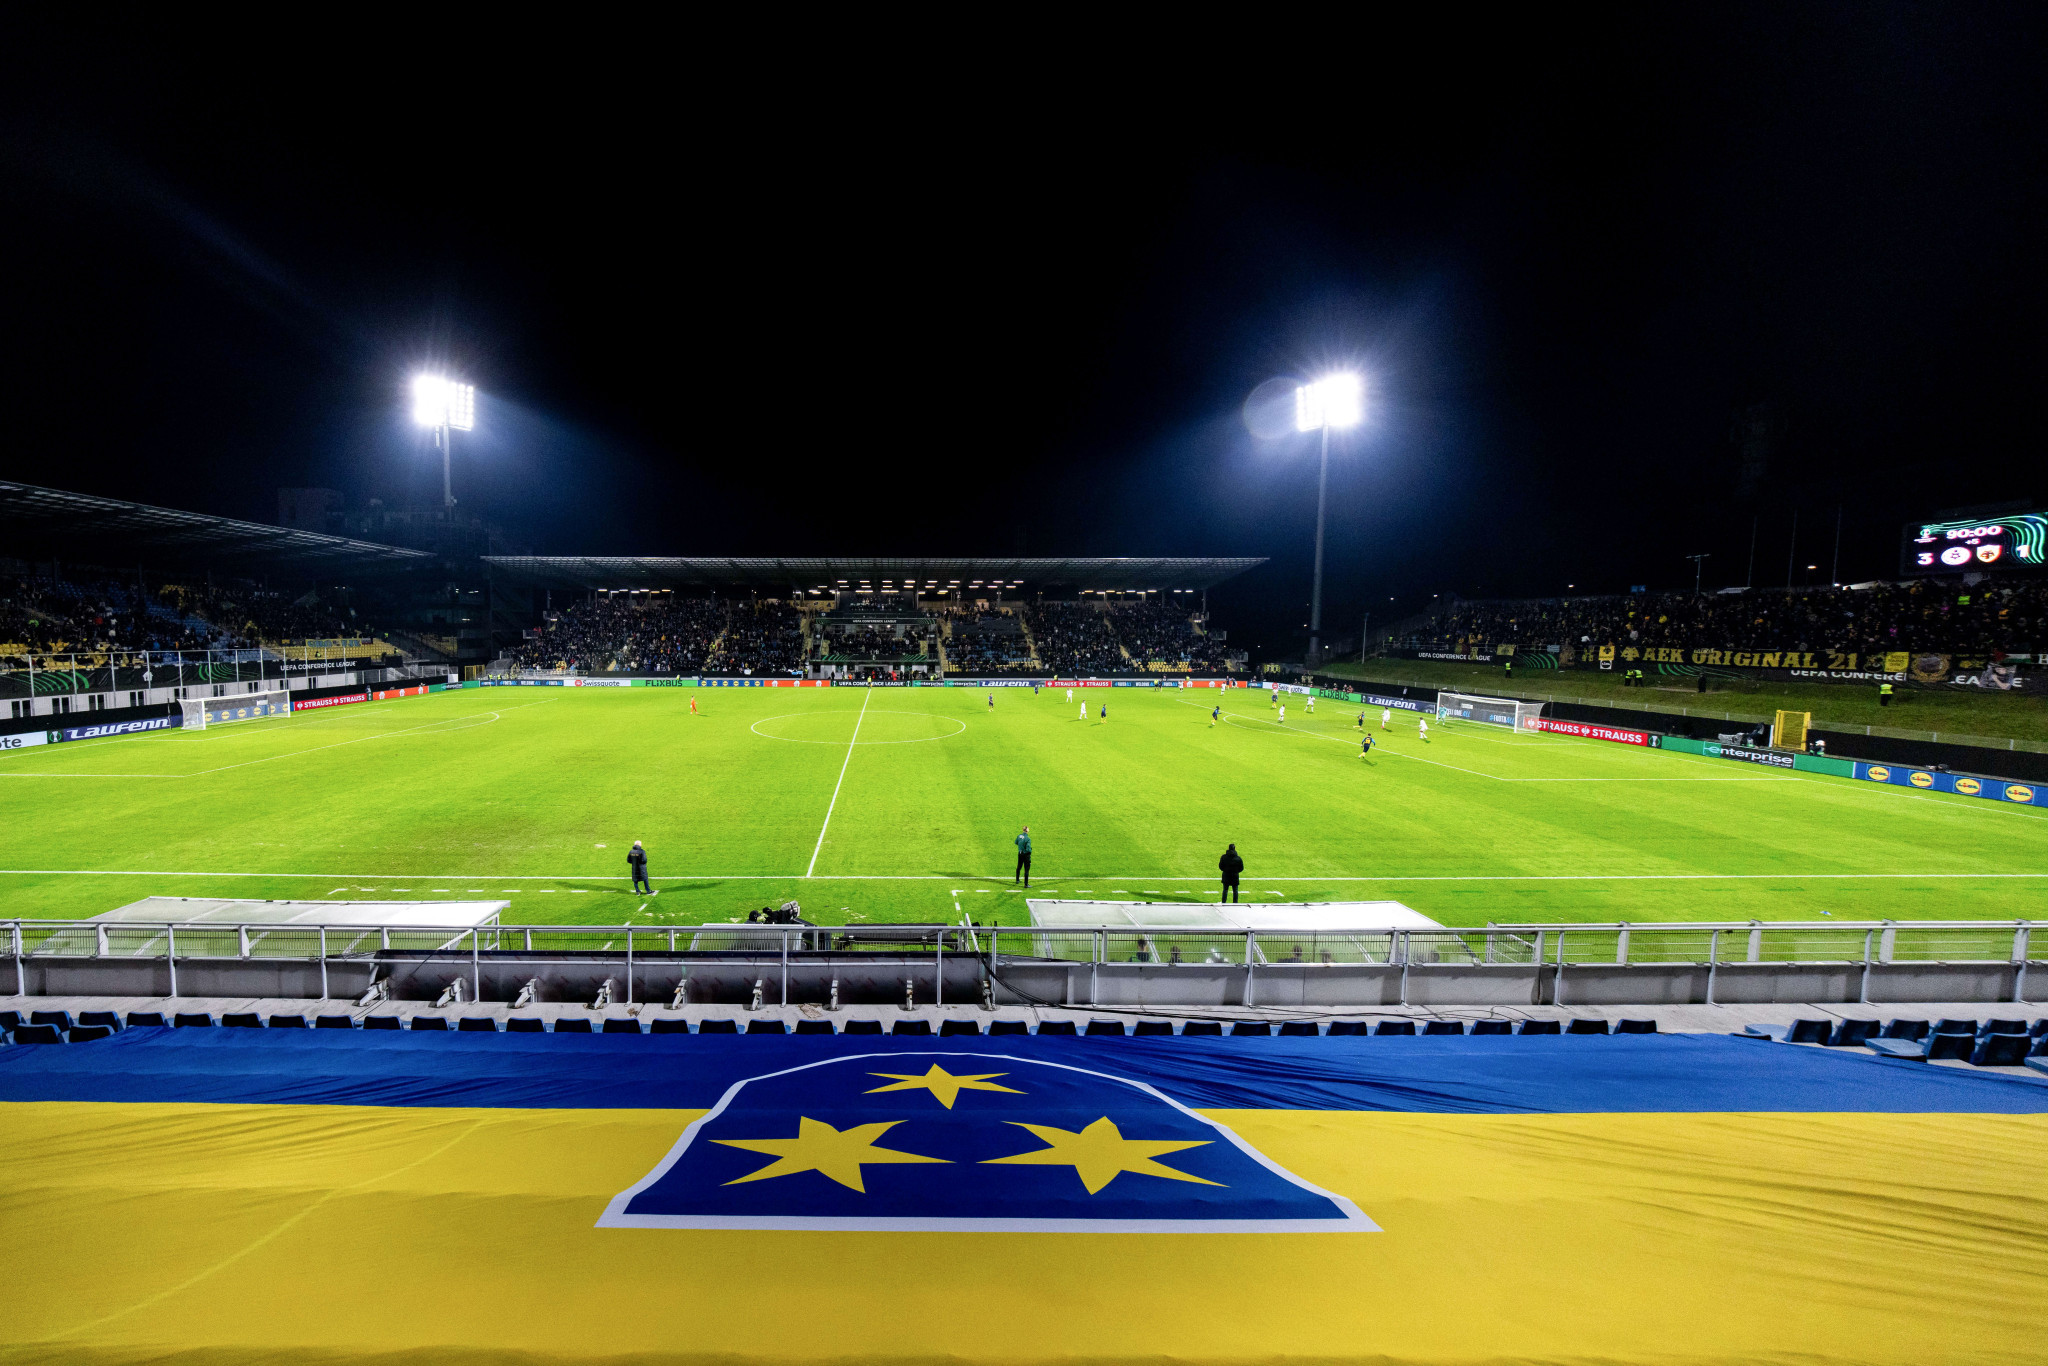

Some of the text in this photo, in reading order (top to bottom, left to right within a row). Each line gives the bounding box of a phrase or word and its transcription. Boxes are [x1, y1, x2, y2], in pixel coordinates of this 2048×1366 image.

[1946, 526, 2003, 539] 90:00
[2016, 544, 2030, 558] 1
[1917, 552, 1934, 565] 3
[1643, 647, 1684, 663] AEK
[1692, 650, 1818, 669] ORIGINAL
[298, 662, 335, 670] CONFERENCE
[304, 695, 365, 708] STRAUSS STRAUSS
[1537, 721, 1643, 743] STRAUSS STRAUSS
[1708, 745, 1793, 764] enterprise
